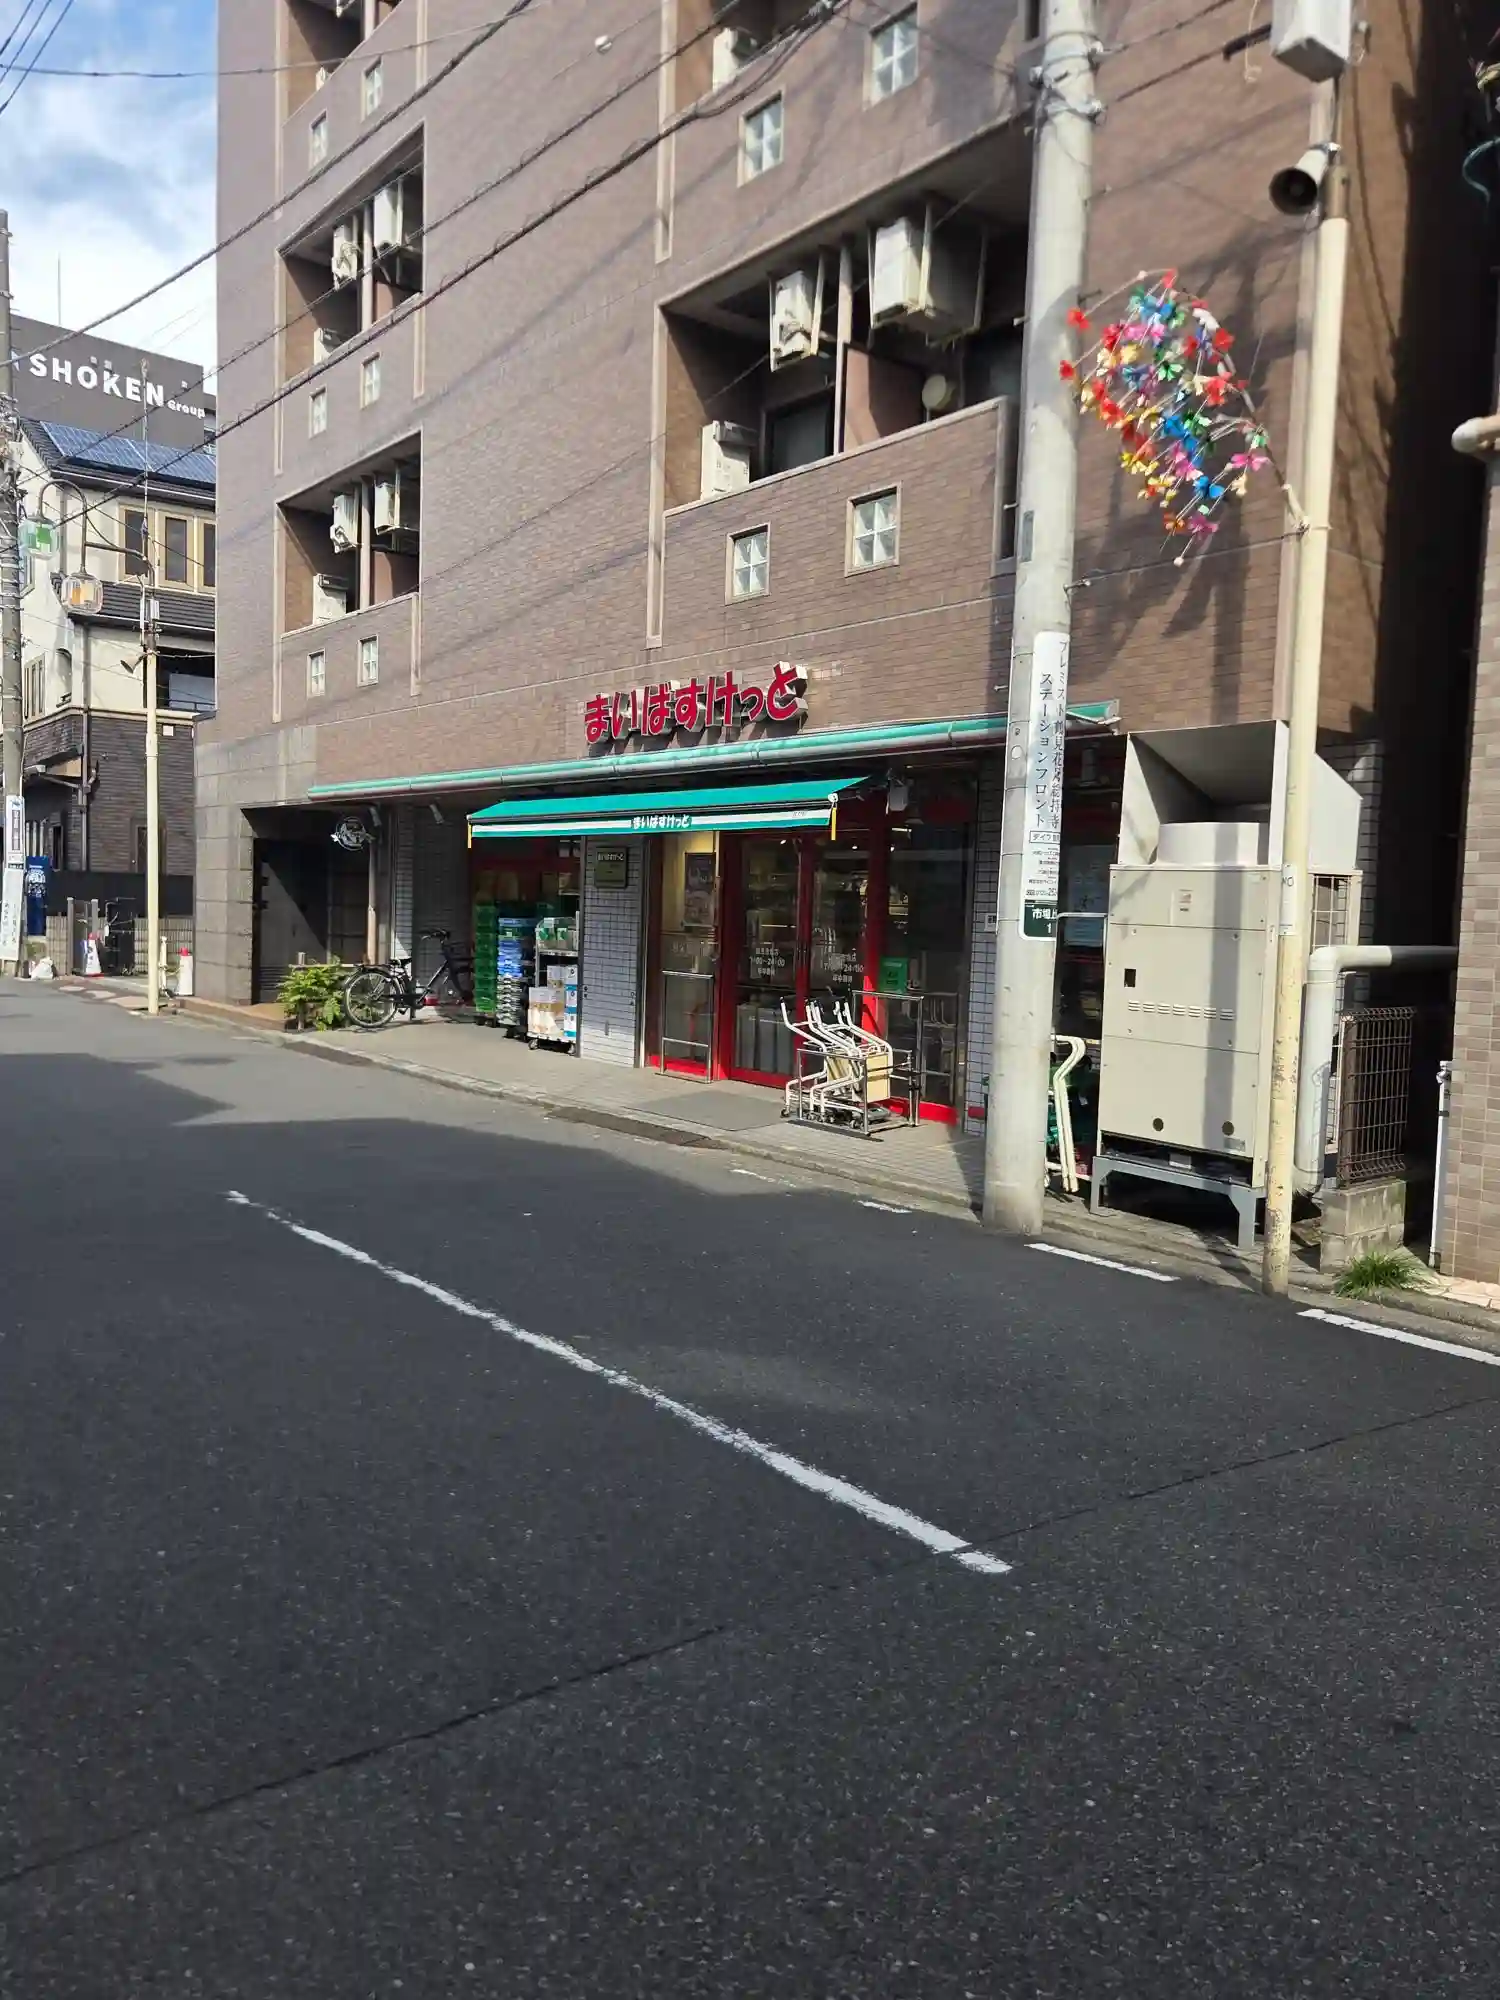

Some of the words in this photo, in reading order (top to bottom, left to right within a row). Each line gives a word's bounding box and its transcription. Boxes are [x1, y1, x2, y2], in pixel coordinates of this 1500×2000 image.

[29, 353, 164, 407] SHOKEN
[167, 399, 206, 419] Group
[585, 661, 799, 744] まいばすけっと
[1034, 672, 1053, 829] ステーションフロント
[632, 813, 692, 830] まいばすけっと
